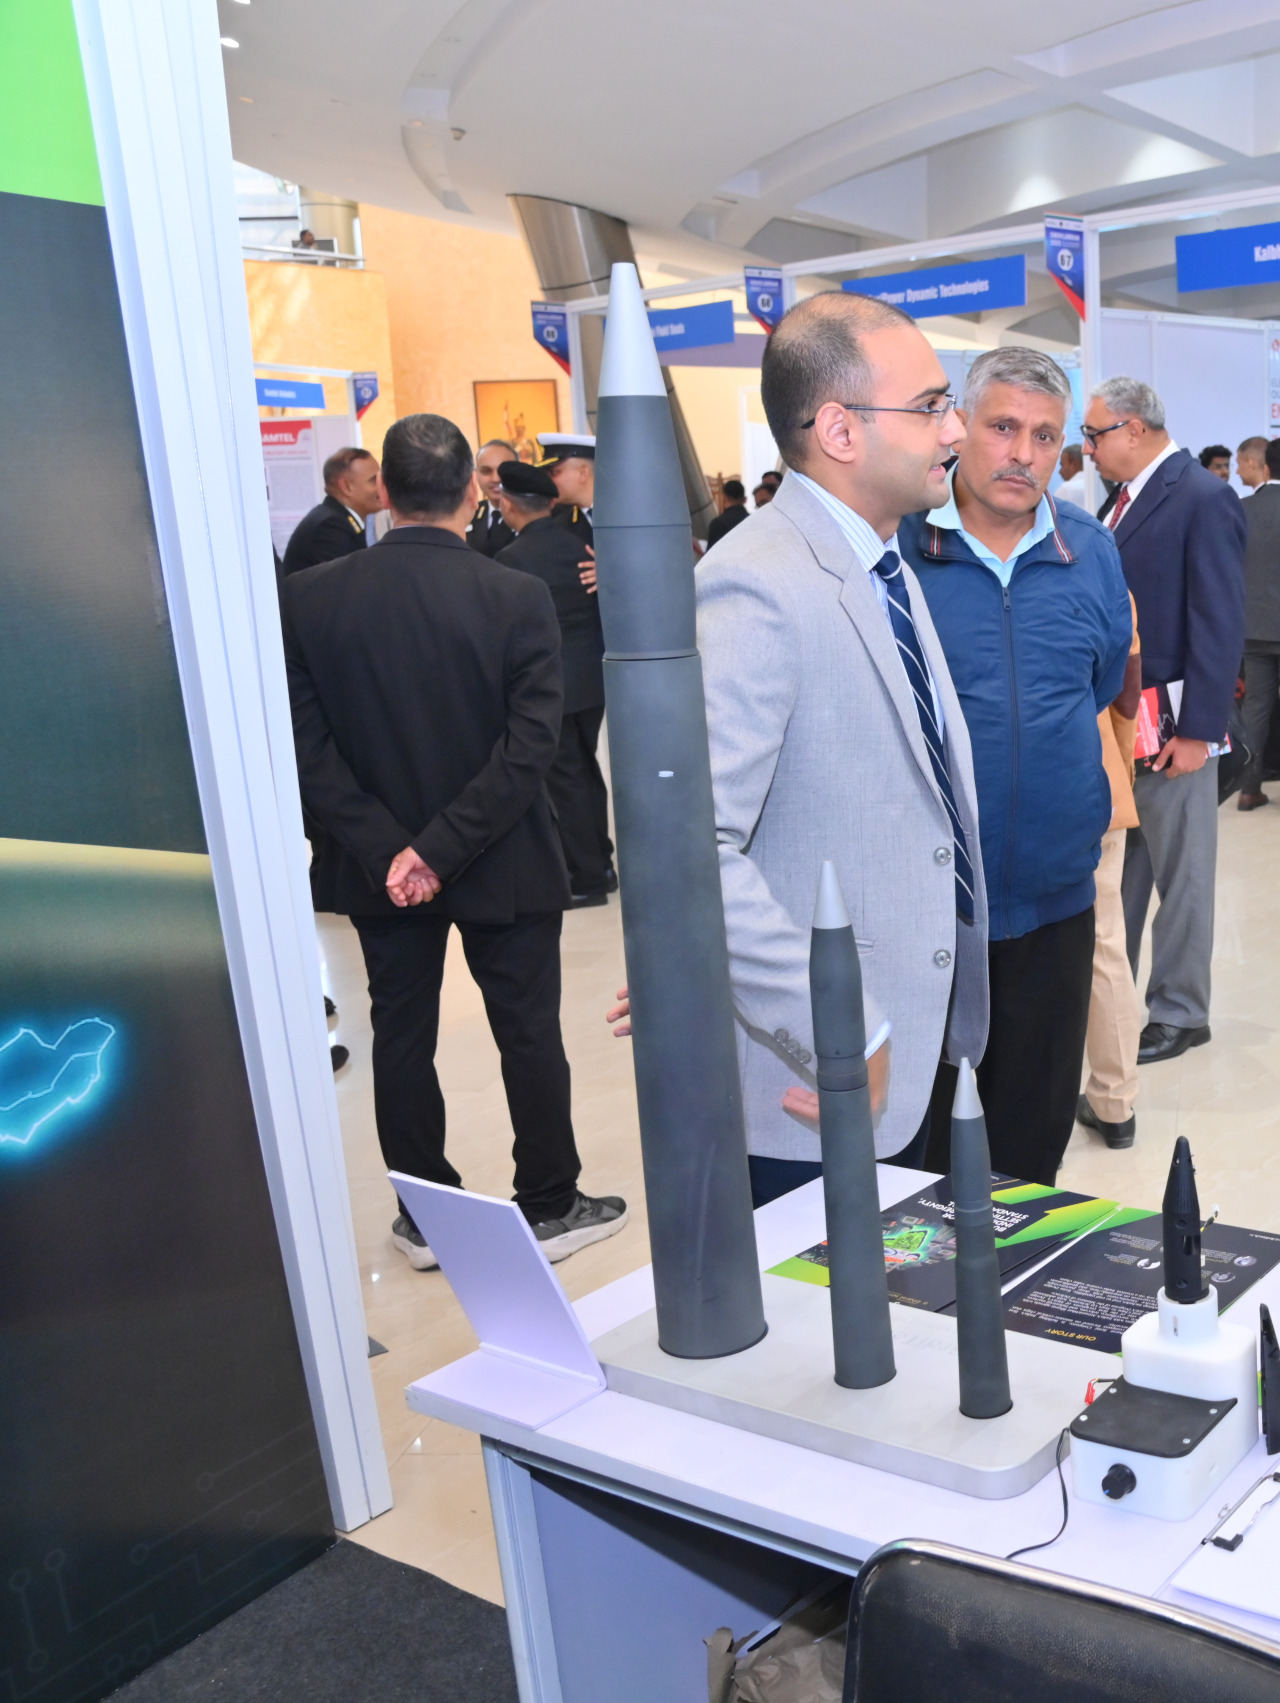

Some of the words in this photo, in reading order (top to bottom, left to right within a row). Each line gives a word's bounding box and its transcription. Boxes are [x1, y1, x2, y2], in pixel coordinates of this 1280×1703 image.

[906, 286, 939, 303] Dynamic
[939, 278, 990, 298] Technologies
[1044, 1328, 1076, 1338] STORY
[1075, 1333, 1097, 1341] OUR
